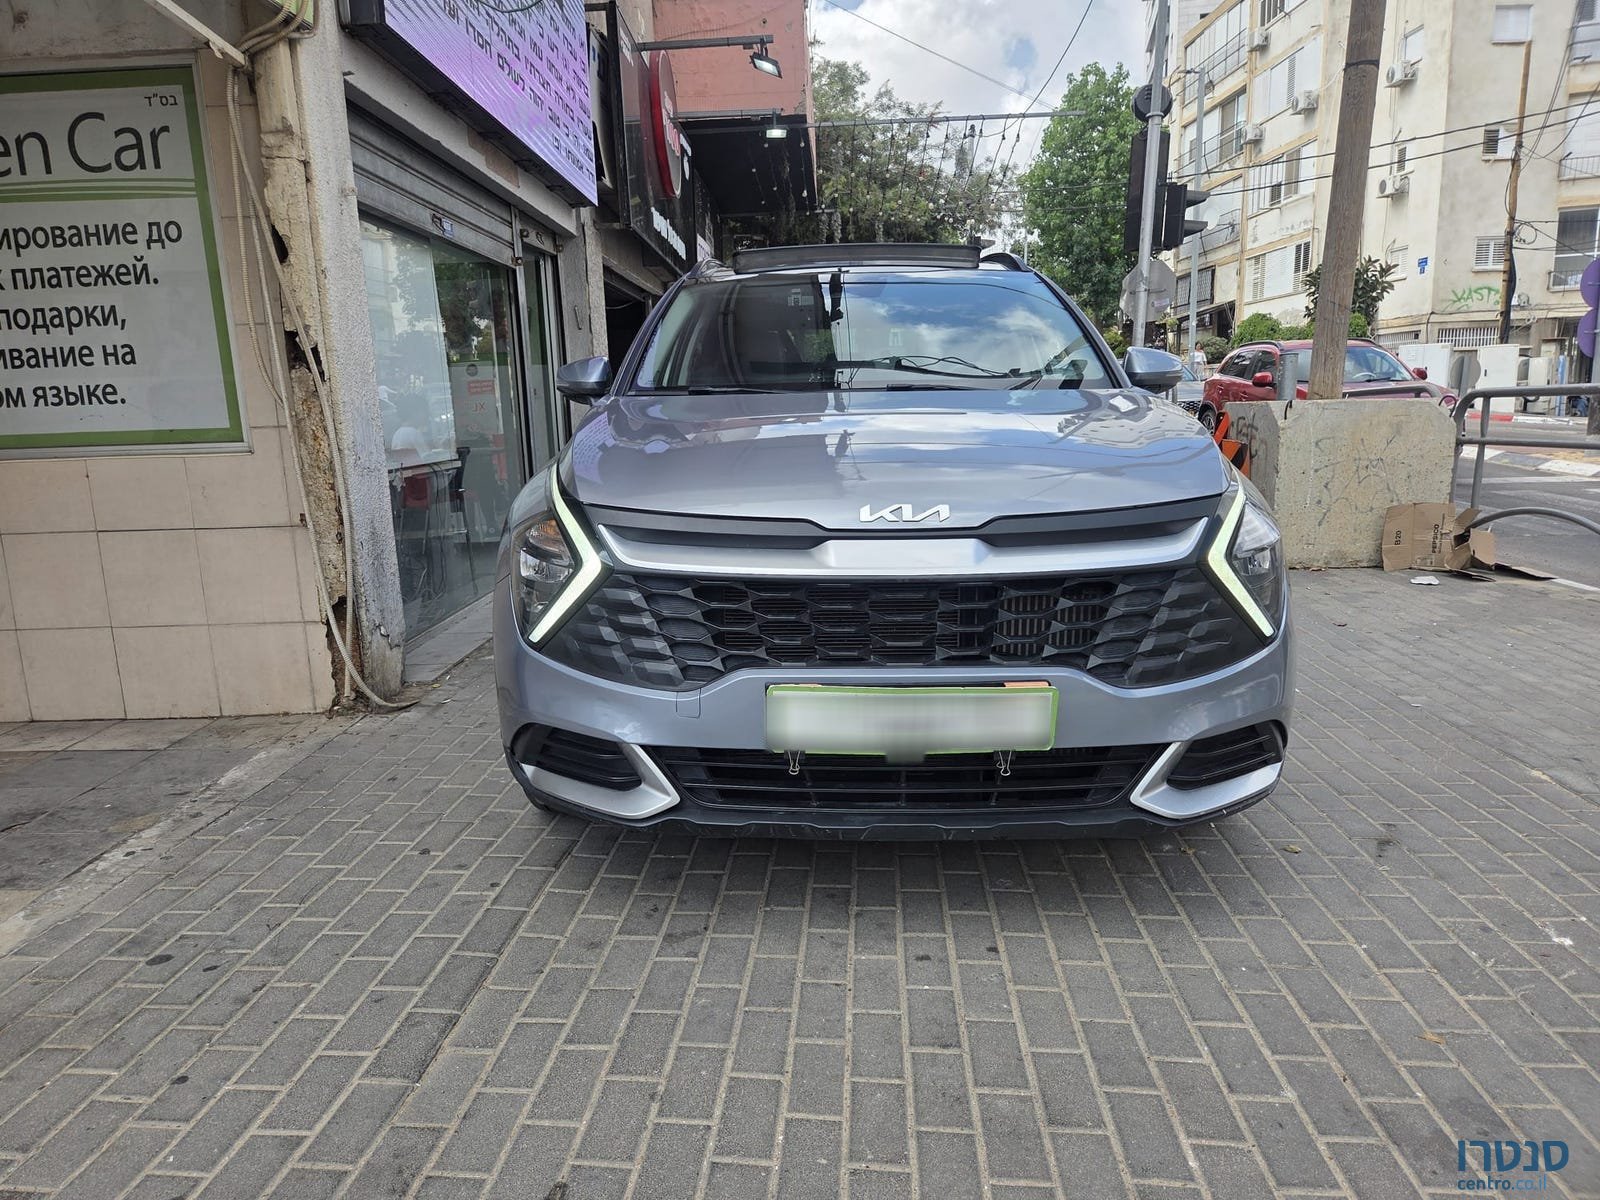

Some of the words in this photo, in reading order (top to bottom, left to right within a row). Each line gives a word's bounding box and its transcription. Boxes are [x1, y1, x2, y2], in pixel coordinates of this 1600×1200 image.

[465, 17, 493, 60] חסדו
[497, 52, 526, 92] לעולם
[144, 92, 179, 107] בס"ד
[67, 112, 170, 174] Car
[146, 221, 182, 250] до
[11, 256, 158, 291] платежей.
[102, 344, 136, 366] на
[33, 384, 126, 407] языке.
[860, 504, 951, 523] KIA
[1432, 523, 1440, 554] PEPSICO
